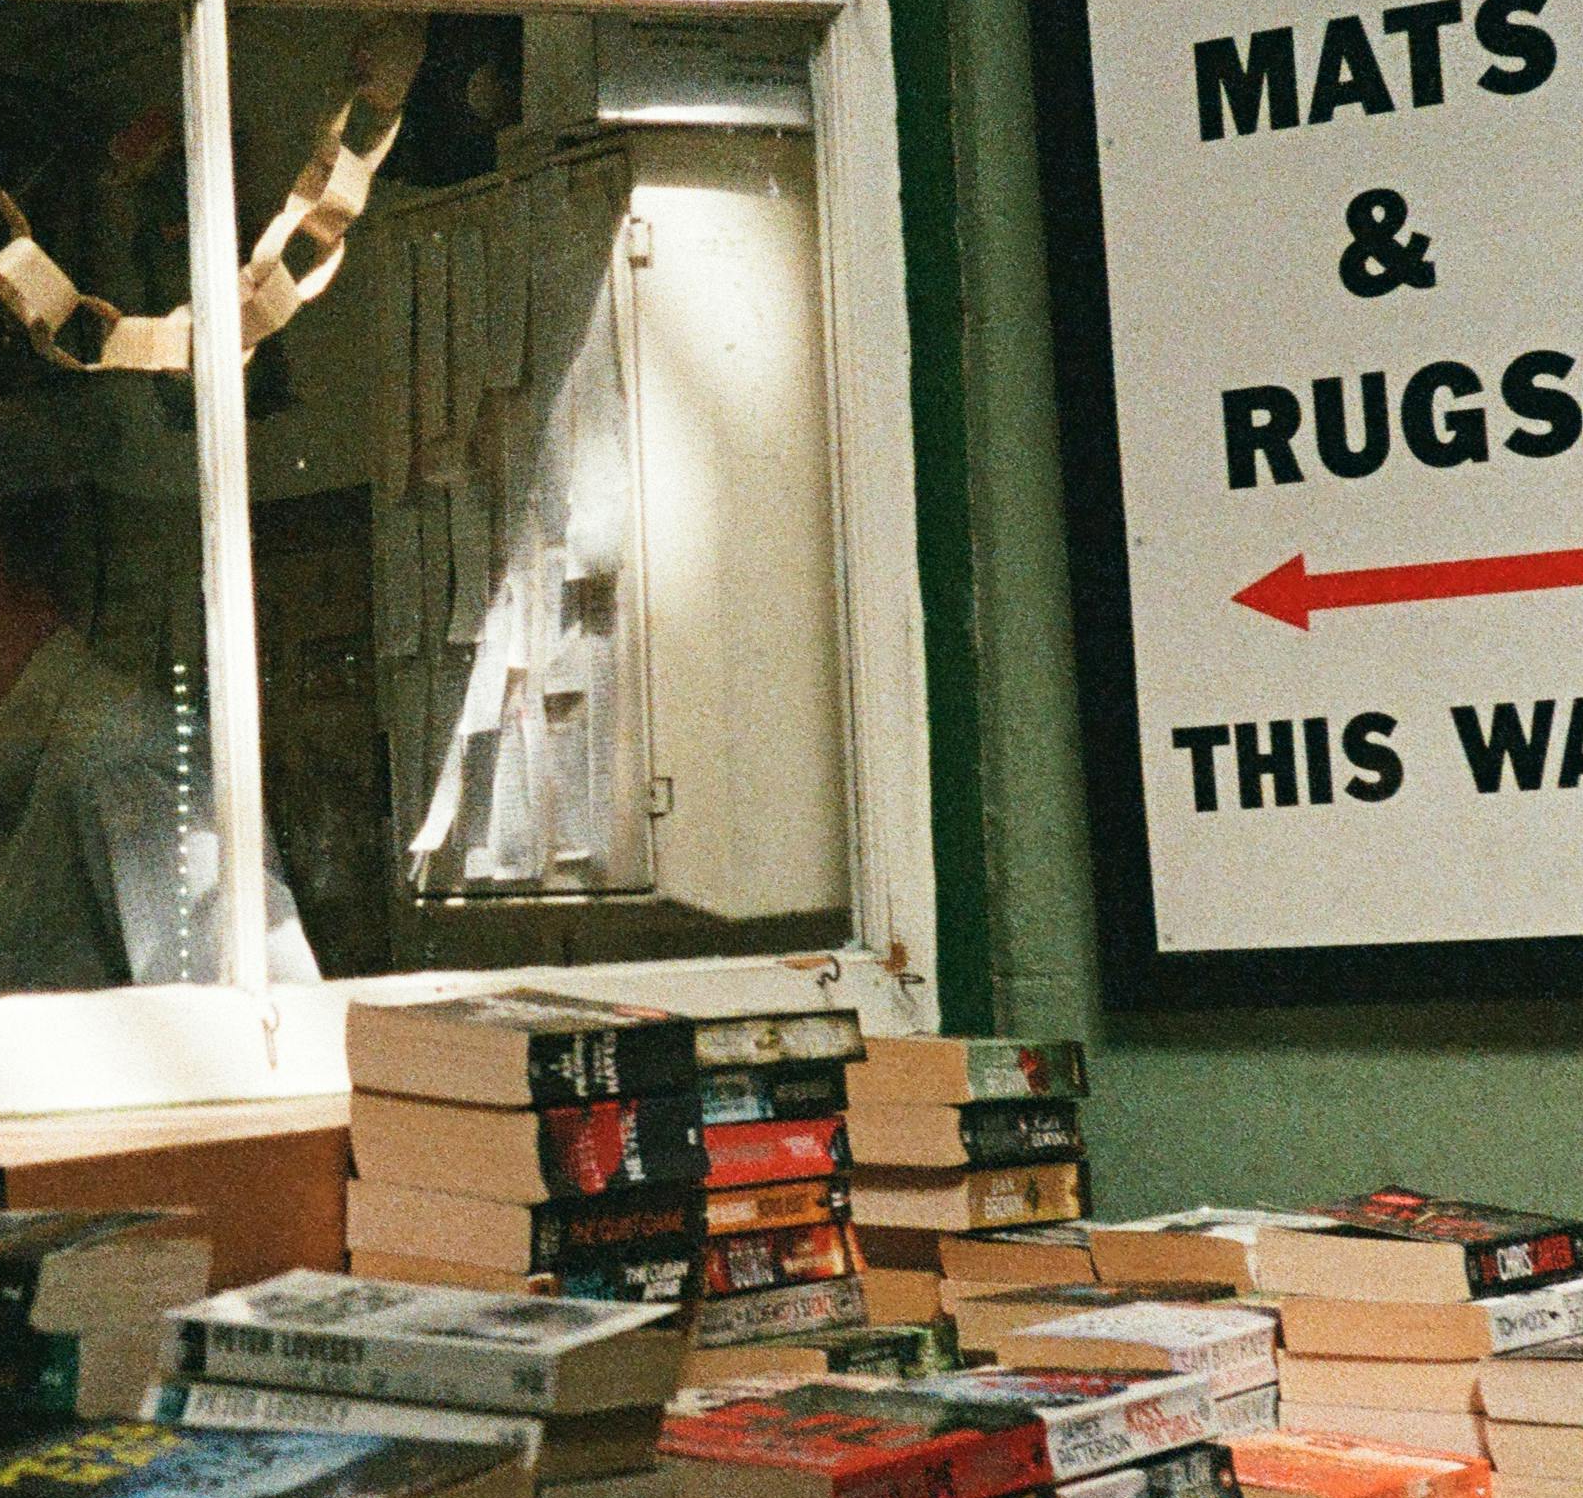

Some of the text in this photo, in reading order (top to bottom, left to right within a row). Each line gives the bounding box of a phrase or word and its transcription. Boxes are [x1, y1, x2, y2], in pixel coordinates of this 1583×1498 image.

[1339, 188, 1436, 298] &
[1221, 350, 1583, 490] RUGS
[1172, 711, 1403, 813] THIS
